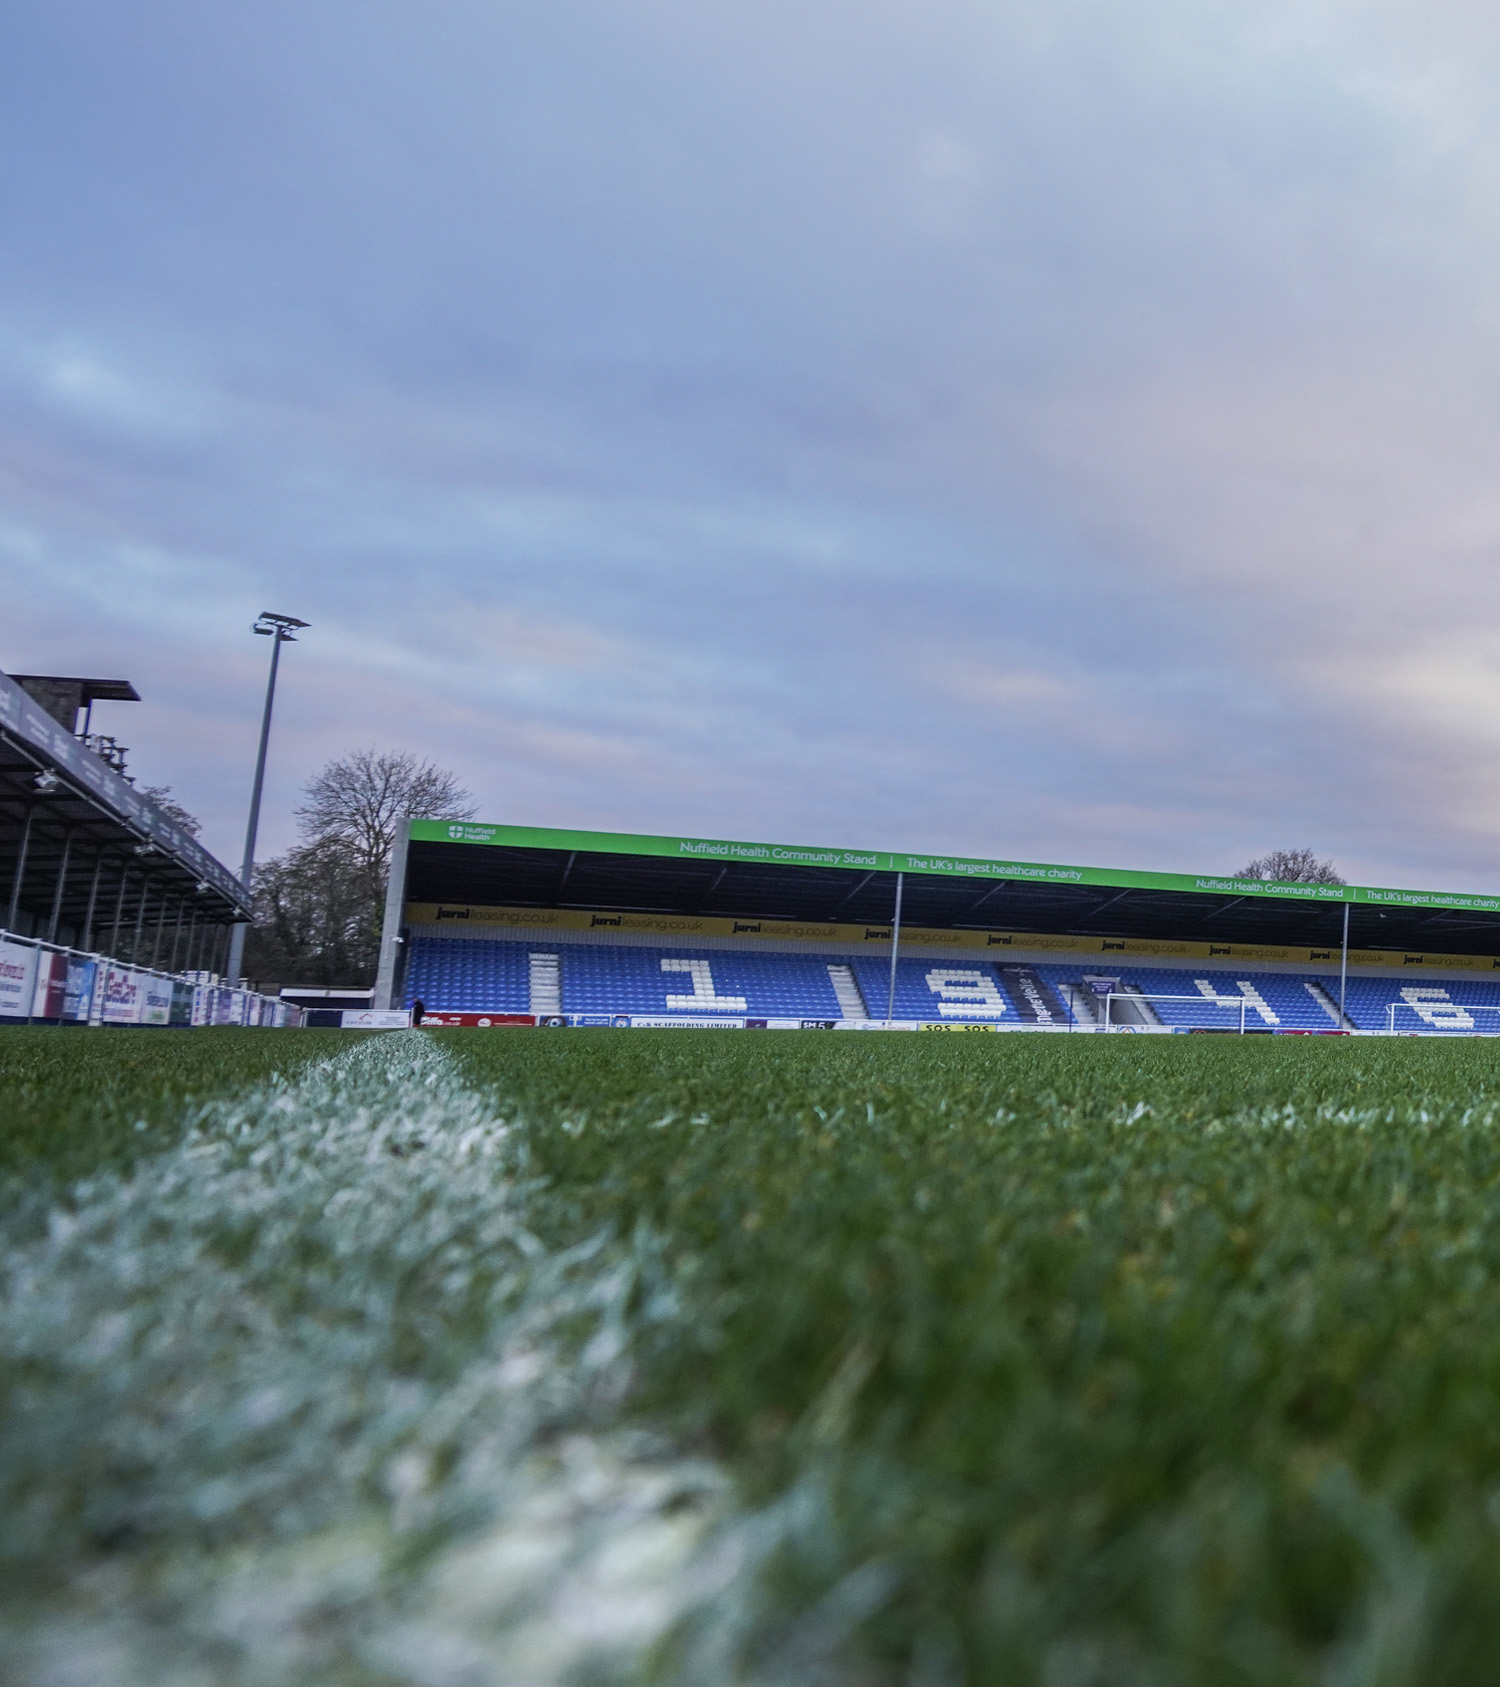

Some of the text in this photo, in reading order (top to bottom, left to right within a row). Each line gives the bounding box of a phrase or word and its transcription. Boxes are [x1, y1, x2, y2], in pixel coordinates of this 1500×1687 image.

[464, 833, 490, 841] Health
[465, 827, 496, 835] Nuffield
[680, 841, 877, 865] Nuffield Health Community Stand
[907, 857, 1083, 881] The UK's largest healthcare charity
[1196, 879, 1344, 897] Nuffield Health Community Stand
[1367, 890, 1500, 909] The UK's largest healthcare charity
